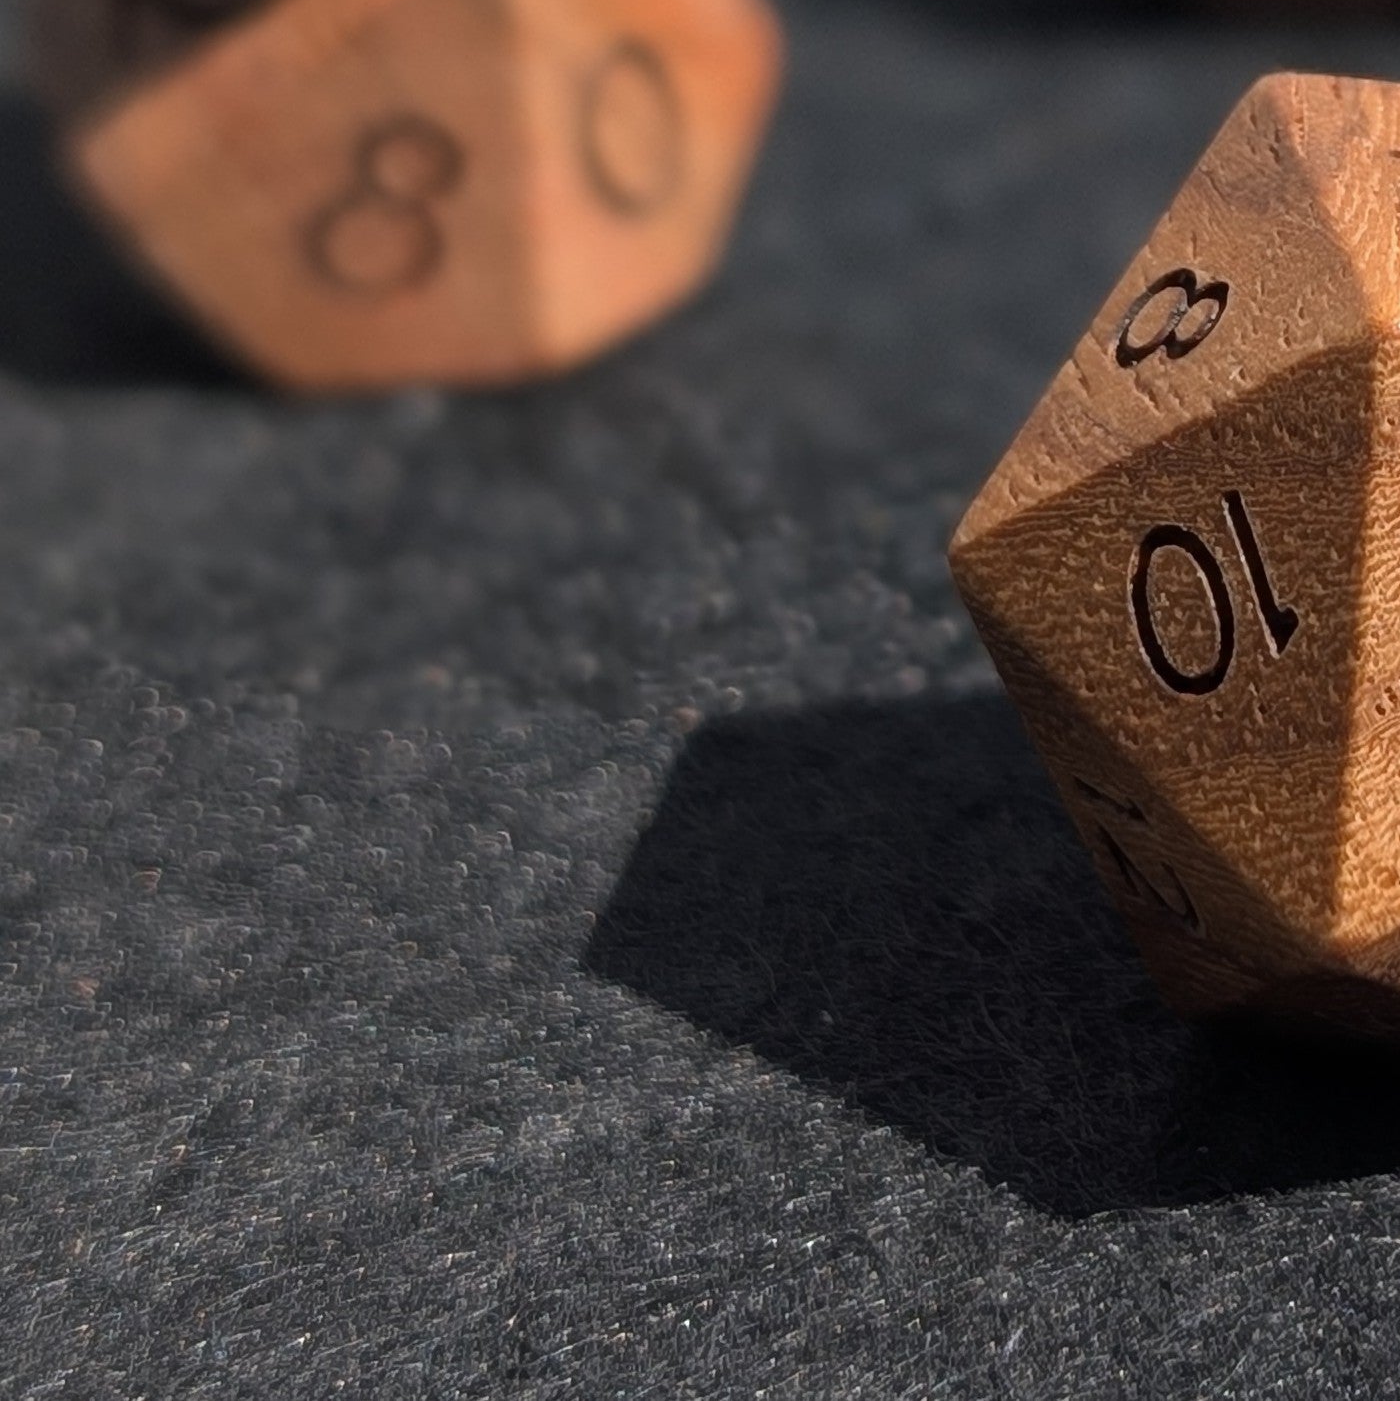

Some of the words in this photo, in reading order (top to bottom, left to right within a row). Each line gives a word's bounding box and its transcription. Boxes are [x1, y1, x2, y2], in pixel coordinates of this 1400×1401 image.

[300, 109, 468, 306] 8
[576, 32, 687, 229] 0
[1114, 267, 1229, 369] 8
[1129, 489, 1299, 696] 10
